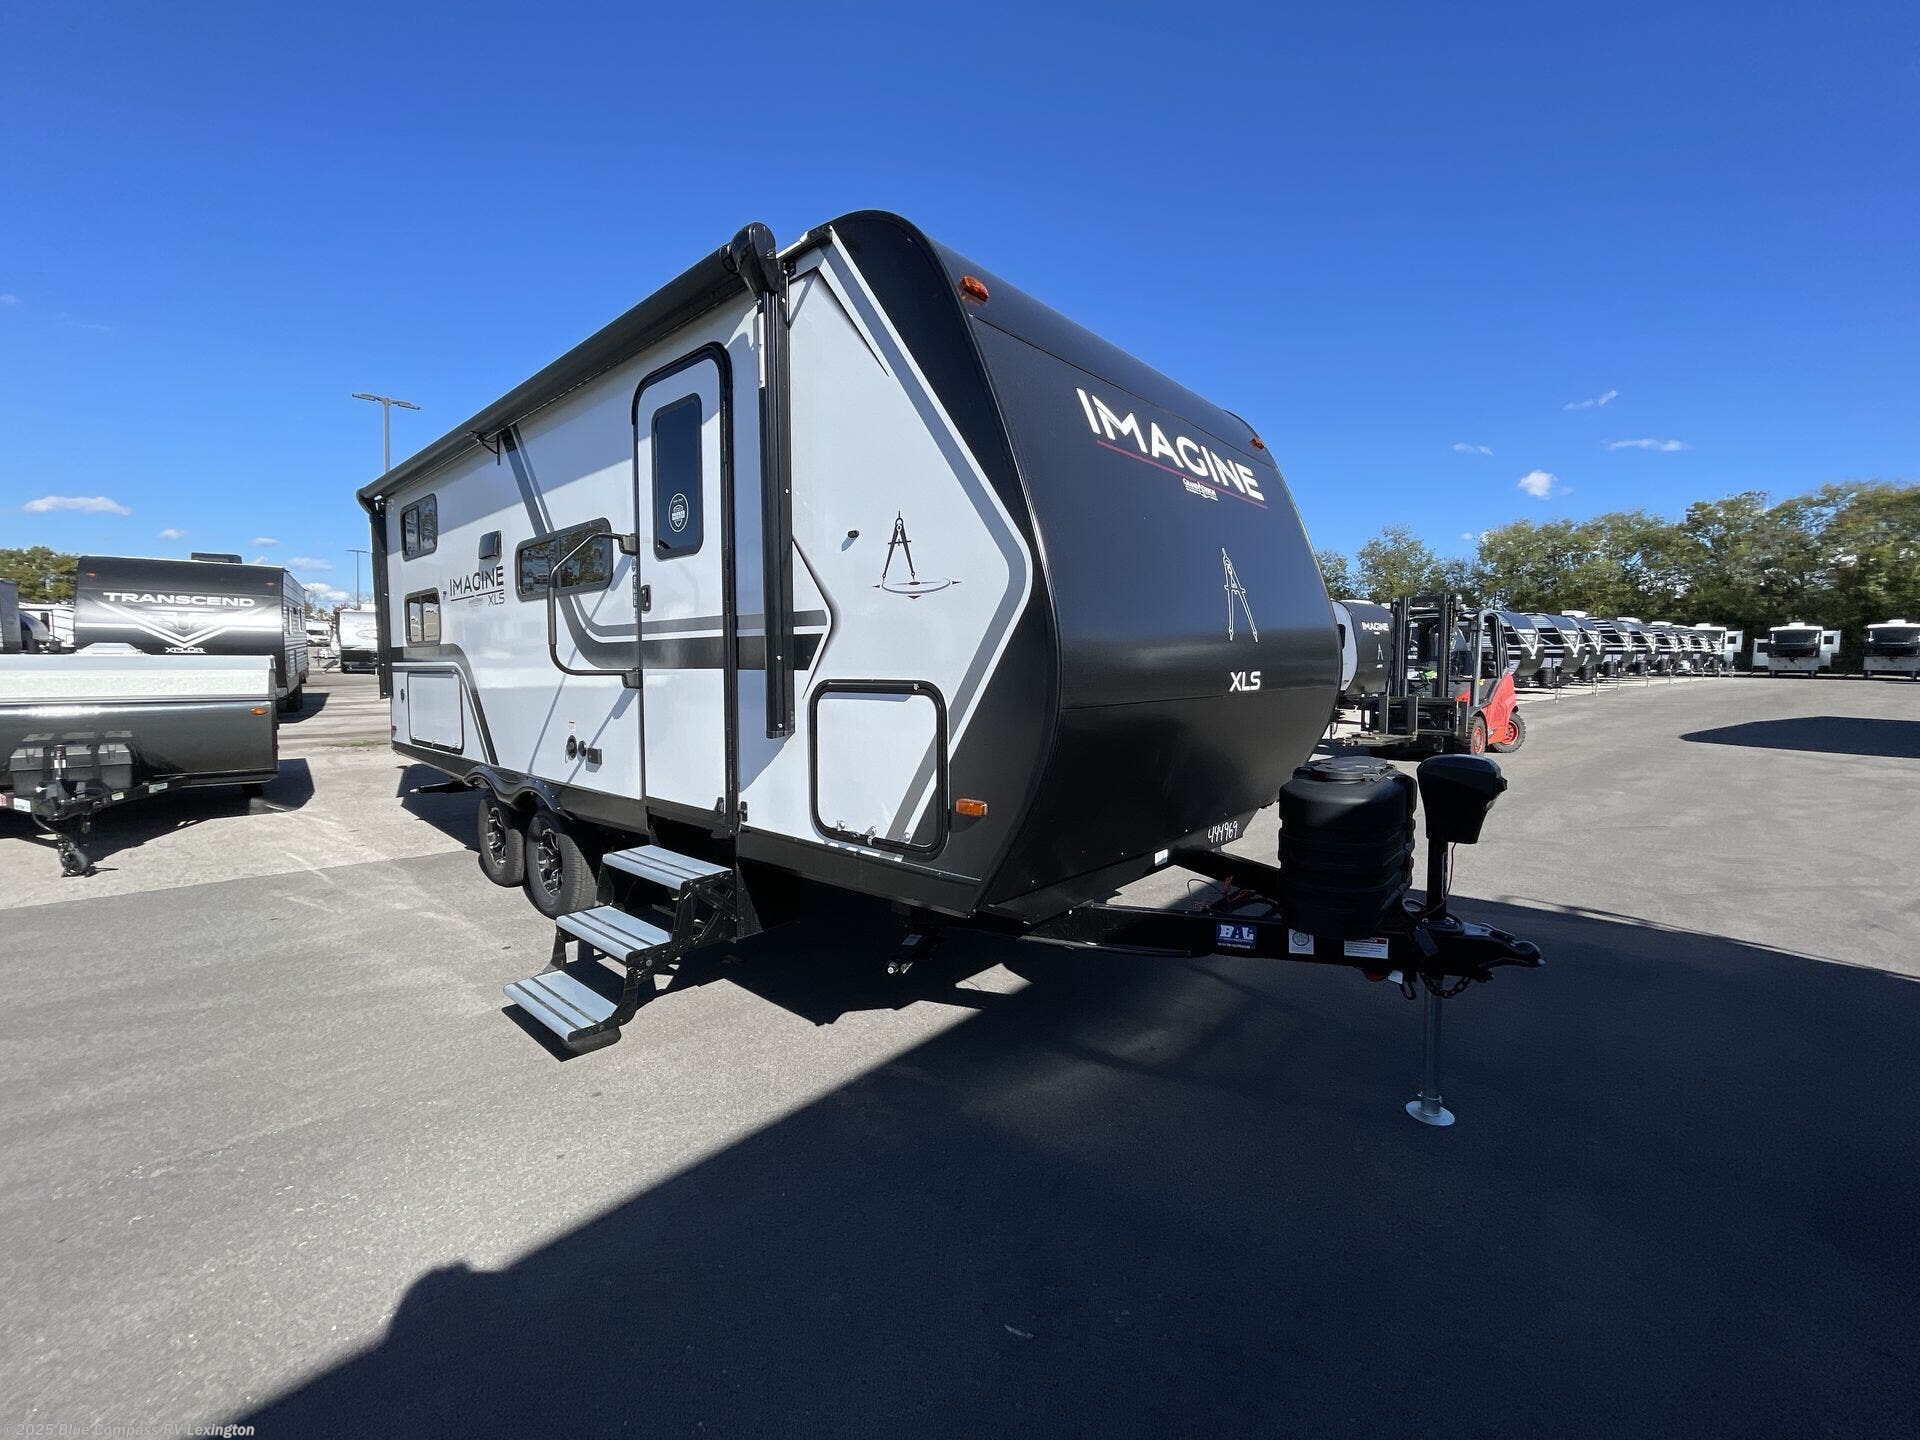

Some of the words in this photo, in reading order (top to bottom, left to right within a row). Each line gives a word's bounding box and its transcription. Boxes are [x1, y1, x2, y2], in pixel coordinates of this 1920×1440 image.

[1076, 387, 1265, 501] IMAGINE
[449, 565, 504, 597] IMAGINE
[102, 591, 256, 608] TRANSCEND
[488, 592, 505, 606] XLS
[1229, 671, 1261, 692] XLS
